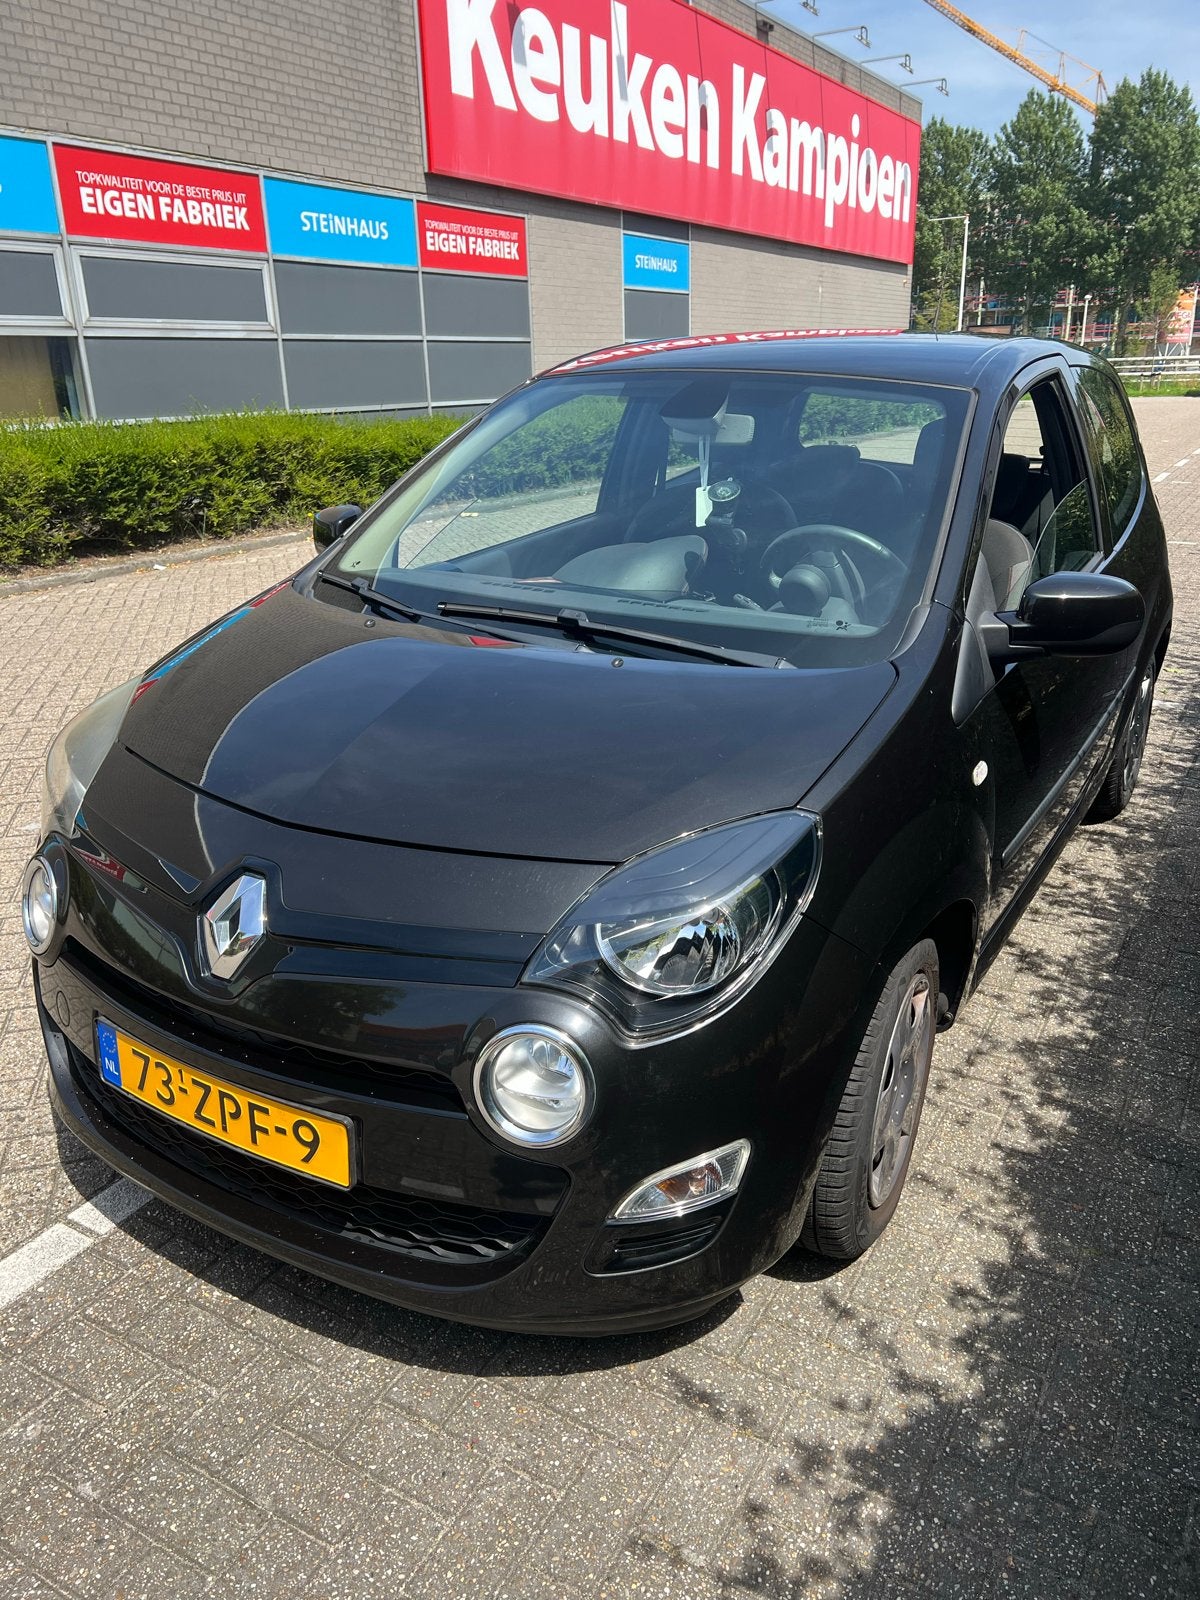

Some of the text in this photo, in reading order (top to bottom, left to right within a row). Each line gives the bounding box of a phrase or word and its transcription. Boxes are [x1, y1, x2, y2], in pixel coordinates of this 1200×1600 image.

[447, 0, 911, 228] Keuken Kampioen
[75, 170, 246, 204] TOPKWALITEIT VOOR DE BESTE PRIJS UIT
[79, 186, 250, 231] EIGEN FABRIEK
[425, 231, 519, 260] EIGEN FABRIEK
[462, 224, 477, 235] VOOR
[477, 226, 484, 236] DE
[484, 228, 498, 238] BESTE
[104, 1057, 119, 1076] NL
